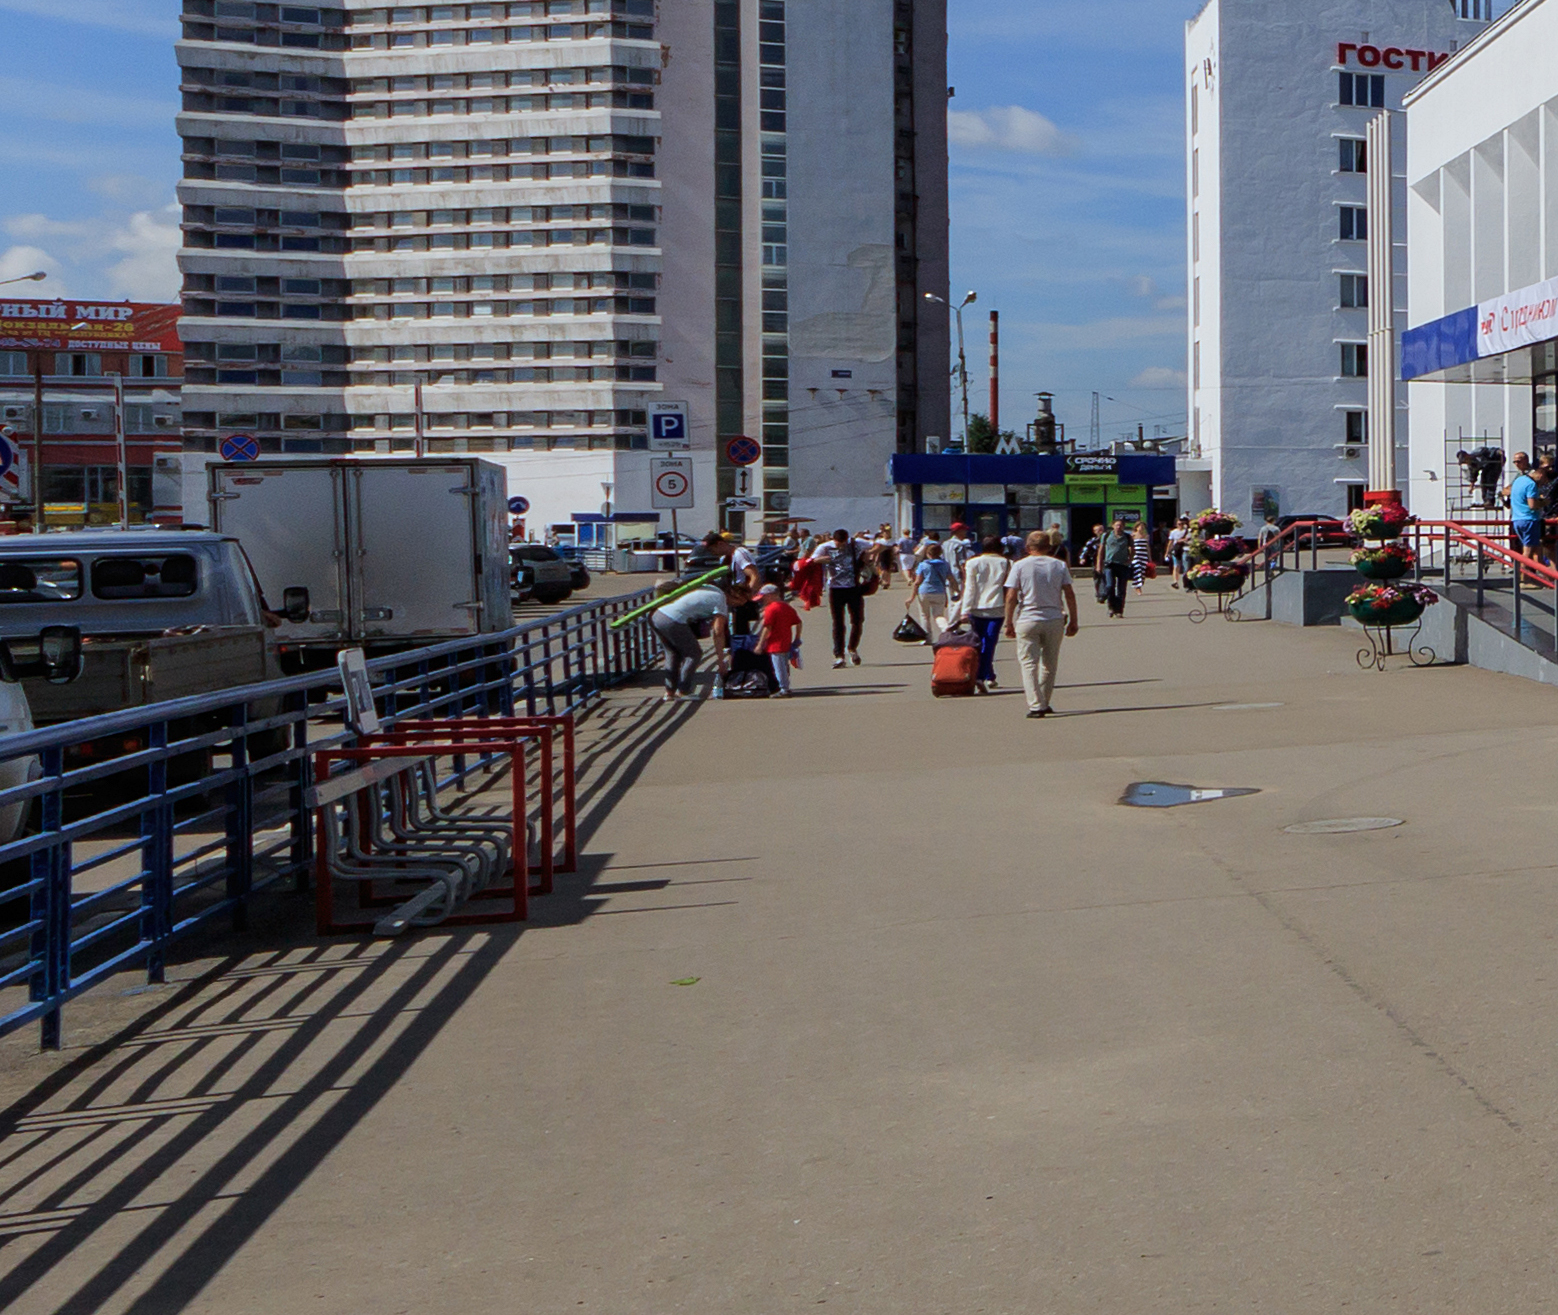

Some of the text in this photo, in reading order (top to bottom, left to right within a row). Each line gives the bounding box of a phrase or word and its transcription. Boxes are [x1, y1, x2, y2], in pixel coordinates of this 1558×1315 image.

[0, 302, 133, 320] НЫЙ МИР
[0, 321, 135, 331] окзальая-26
[661, 417, 679, 437] P
[668, 479, 677, 490] 5
